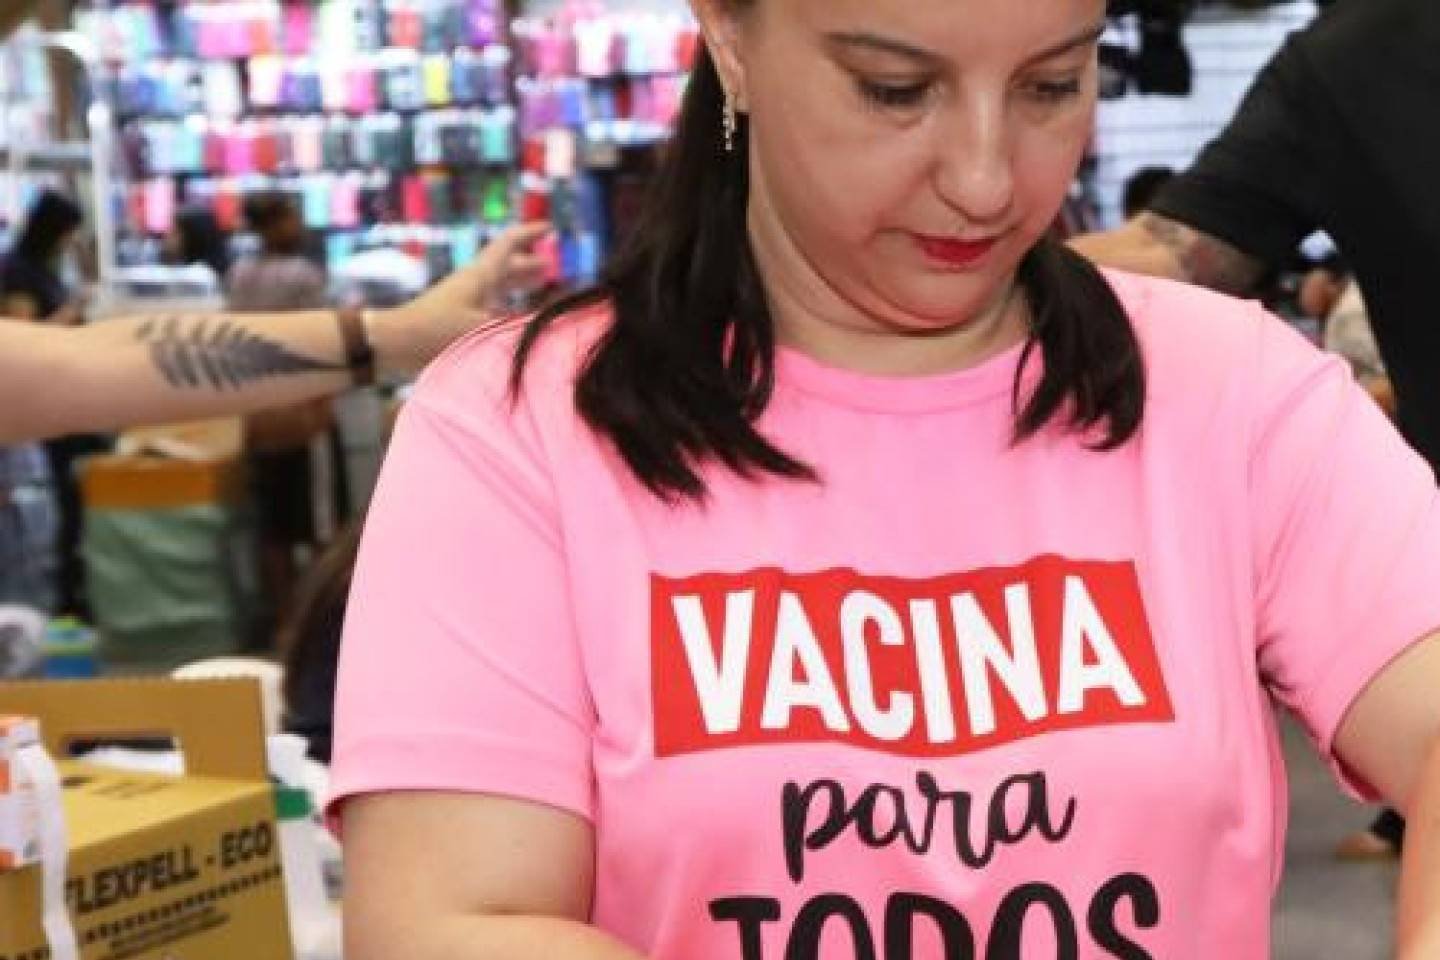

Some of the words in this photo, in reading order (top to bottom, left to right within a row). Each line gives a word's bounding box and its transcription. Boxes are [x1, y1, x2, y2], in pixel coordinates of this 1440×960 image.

[670, 575, 1145, 744] VACINA
[221, 820, 273, 868] ECO
[780, 771, 1076, 883] para
